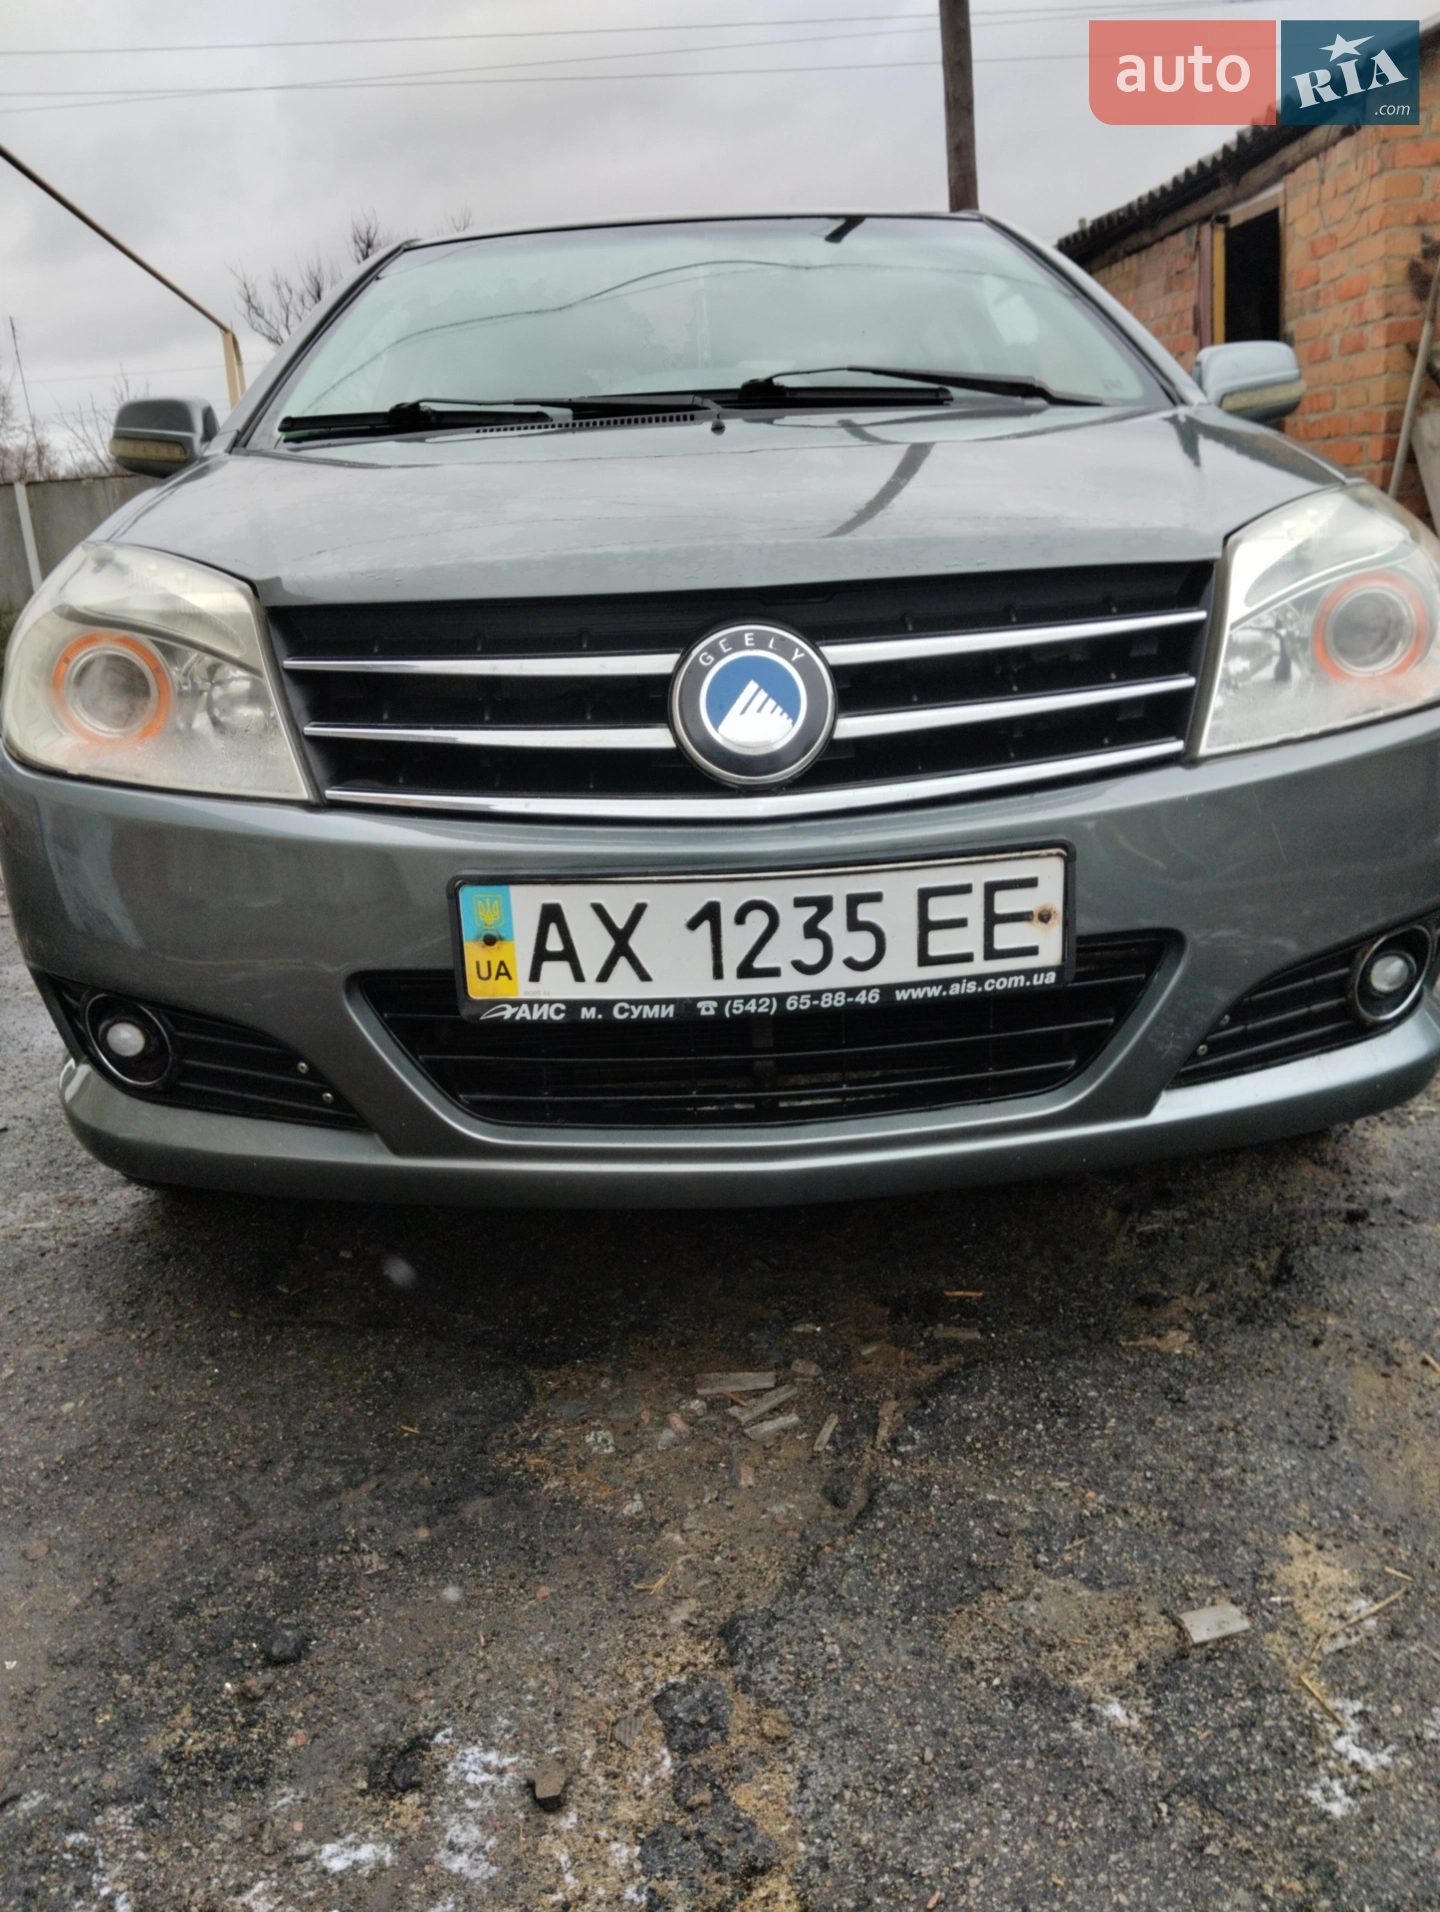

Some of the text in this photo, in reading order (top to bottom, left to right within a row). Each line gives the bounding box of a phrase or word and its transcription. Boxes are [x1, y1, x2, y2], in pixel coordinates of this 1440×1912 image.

[698, 632, 805, 666] GEELY
[528, 876, 1039, 982] AX 1235 EE
[475, 960, 513, 981] UA
[724, 998, 778, 1018] (542)
[785, 988, 881, 1011] 65-88-46
[895, 971, 1057, 1002] www.ais.com.ua
